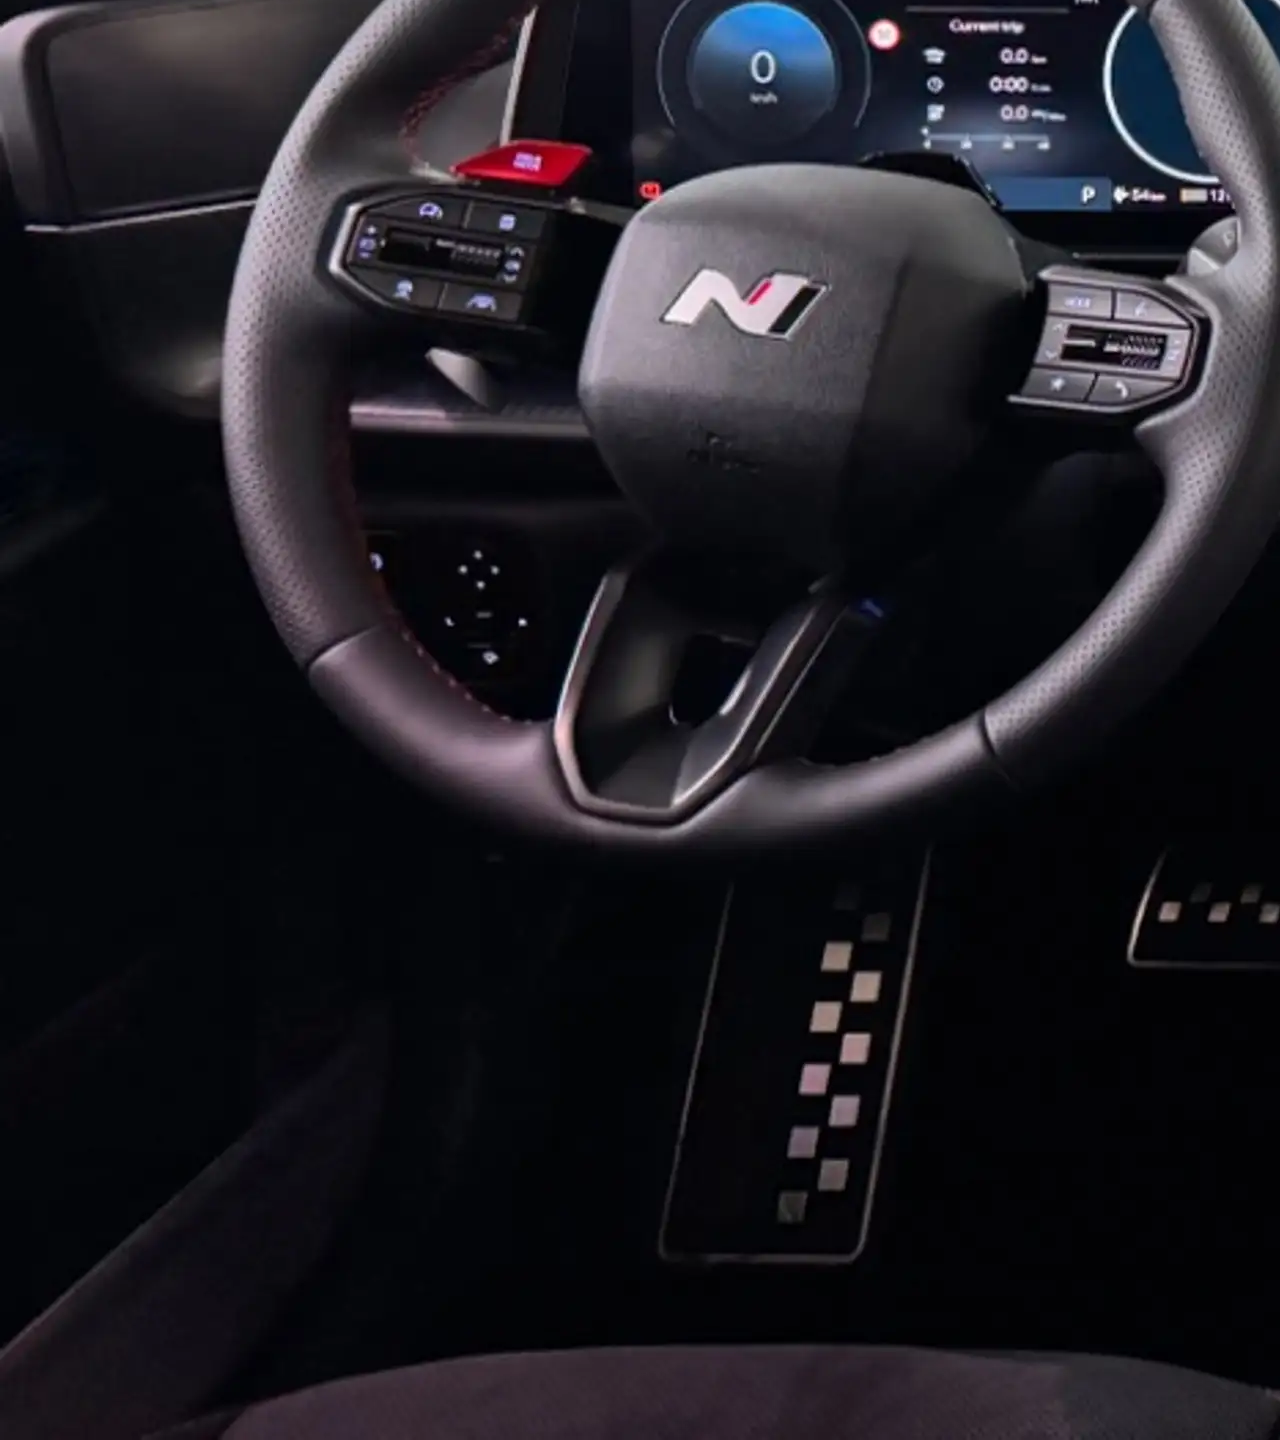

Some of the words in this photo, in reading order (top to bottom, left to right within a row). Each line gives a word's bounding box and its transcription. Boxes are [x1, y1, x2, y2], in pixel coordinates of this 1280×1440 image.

[949, 18, 1000, 34] Current
[1000, 47, 1029, 64] 0.0
[751, 49, 776, 84] 0
[989, 75, 1029, 93] 0:00
[1000, 104, 1029, 122] 0.0
[1081, 185, 1096, 204] P
